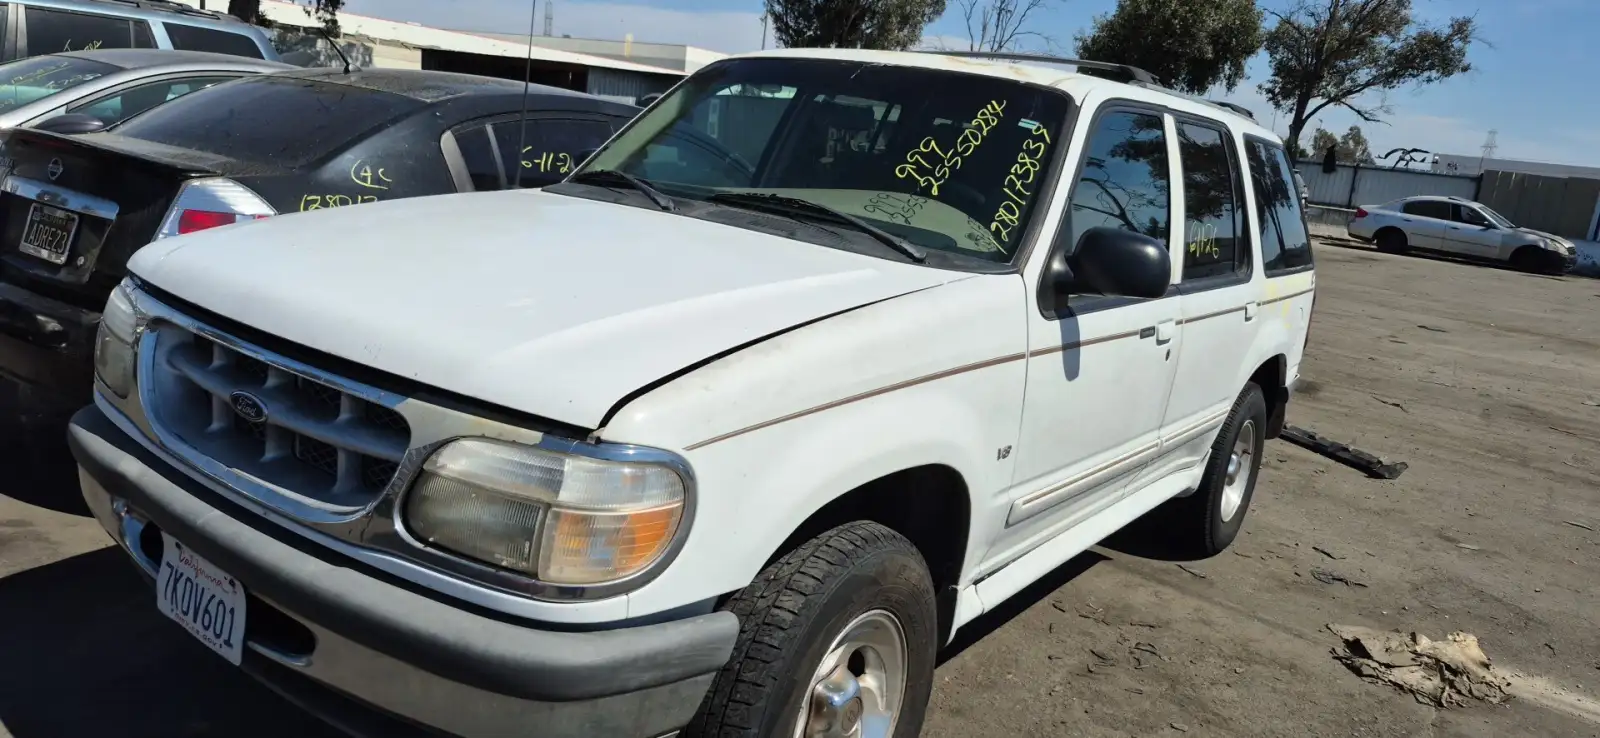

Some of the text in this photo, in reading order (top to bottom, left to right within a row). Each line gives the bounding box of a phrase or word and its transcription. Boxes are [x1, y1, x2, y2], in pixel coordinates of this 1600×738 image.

[896, 136, 947, 187] 999
[921, 100, 1006, 195] 25550284
[27, 223, 68, 254] ADRE23
[237, 396, 257, 417] Ford
